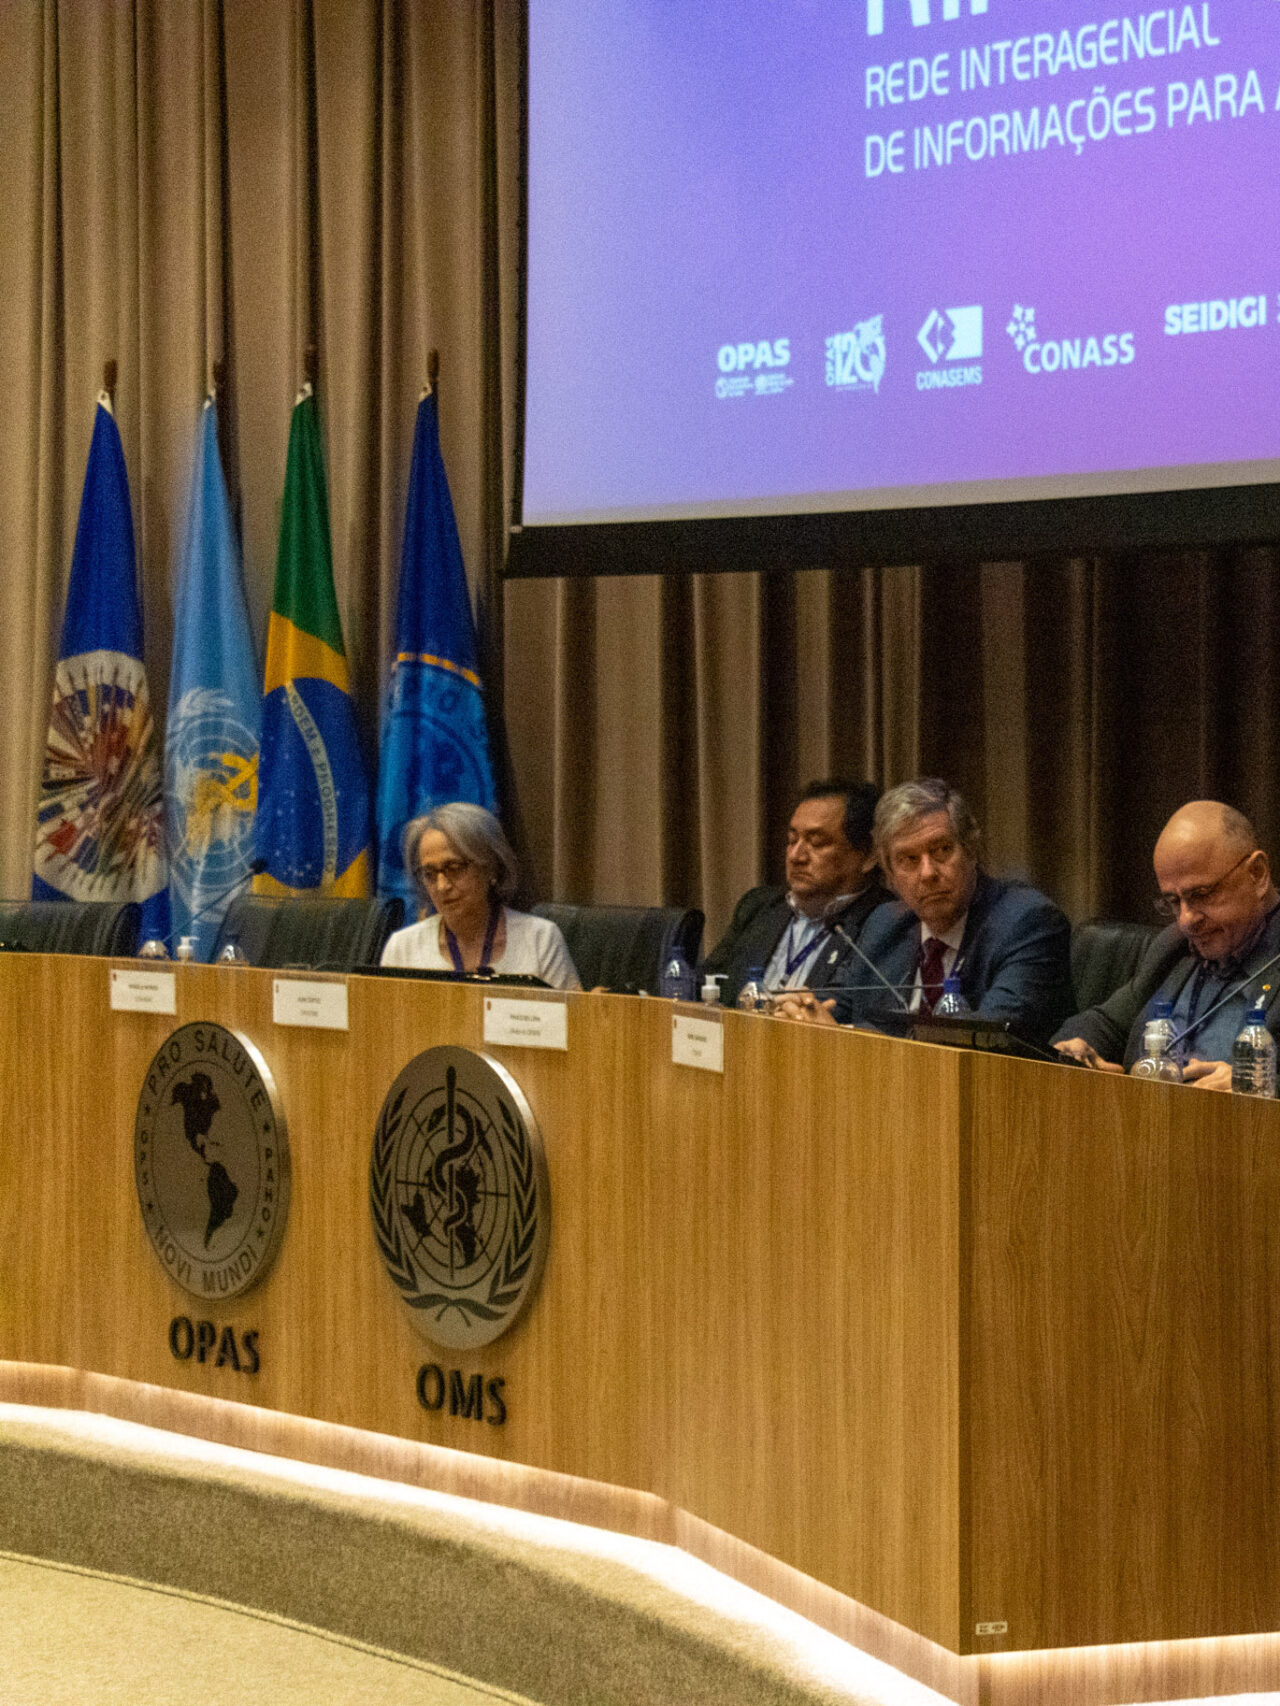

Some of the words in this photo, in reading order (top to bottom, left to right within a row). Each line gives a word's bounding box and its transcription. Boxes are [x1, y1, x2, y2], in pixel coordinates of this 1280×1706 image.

[865, 53, 949, 108] REDE
[960, 4, 1220, 92] INTERAGENCIAL
[865, 130, 904, 178] DE
[914, 86, 1156, 170] INFORMAÇÕES
[1167, 69, 1265, 128] PARA
[1164, 295, 1267, 335] SEIDIGI
[718, 338, 791, 372] OPAS
[916, 366, 983, 391] CONASEMS
[1022, 332, 1136, 374] CONASS
[148, 1041, 182, 1096] PRO
[194, 1029, 266, 1113] SALUTE
[154, 1225, 193, 1284] NOVI
[202, 1243, 259, 1292] MUNDI
[169, 1316, 261, 1375] OPAS
[416, 1363, 508, 1426] OMS
